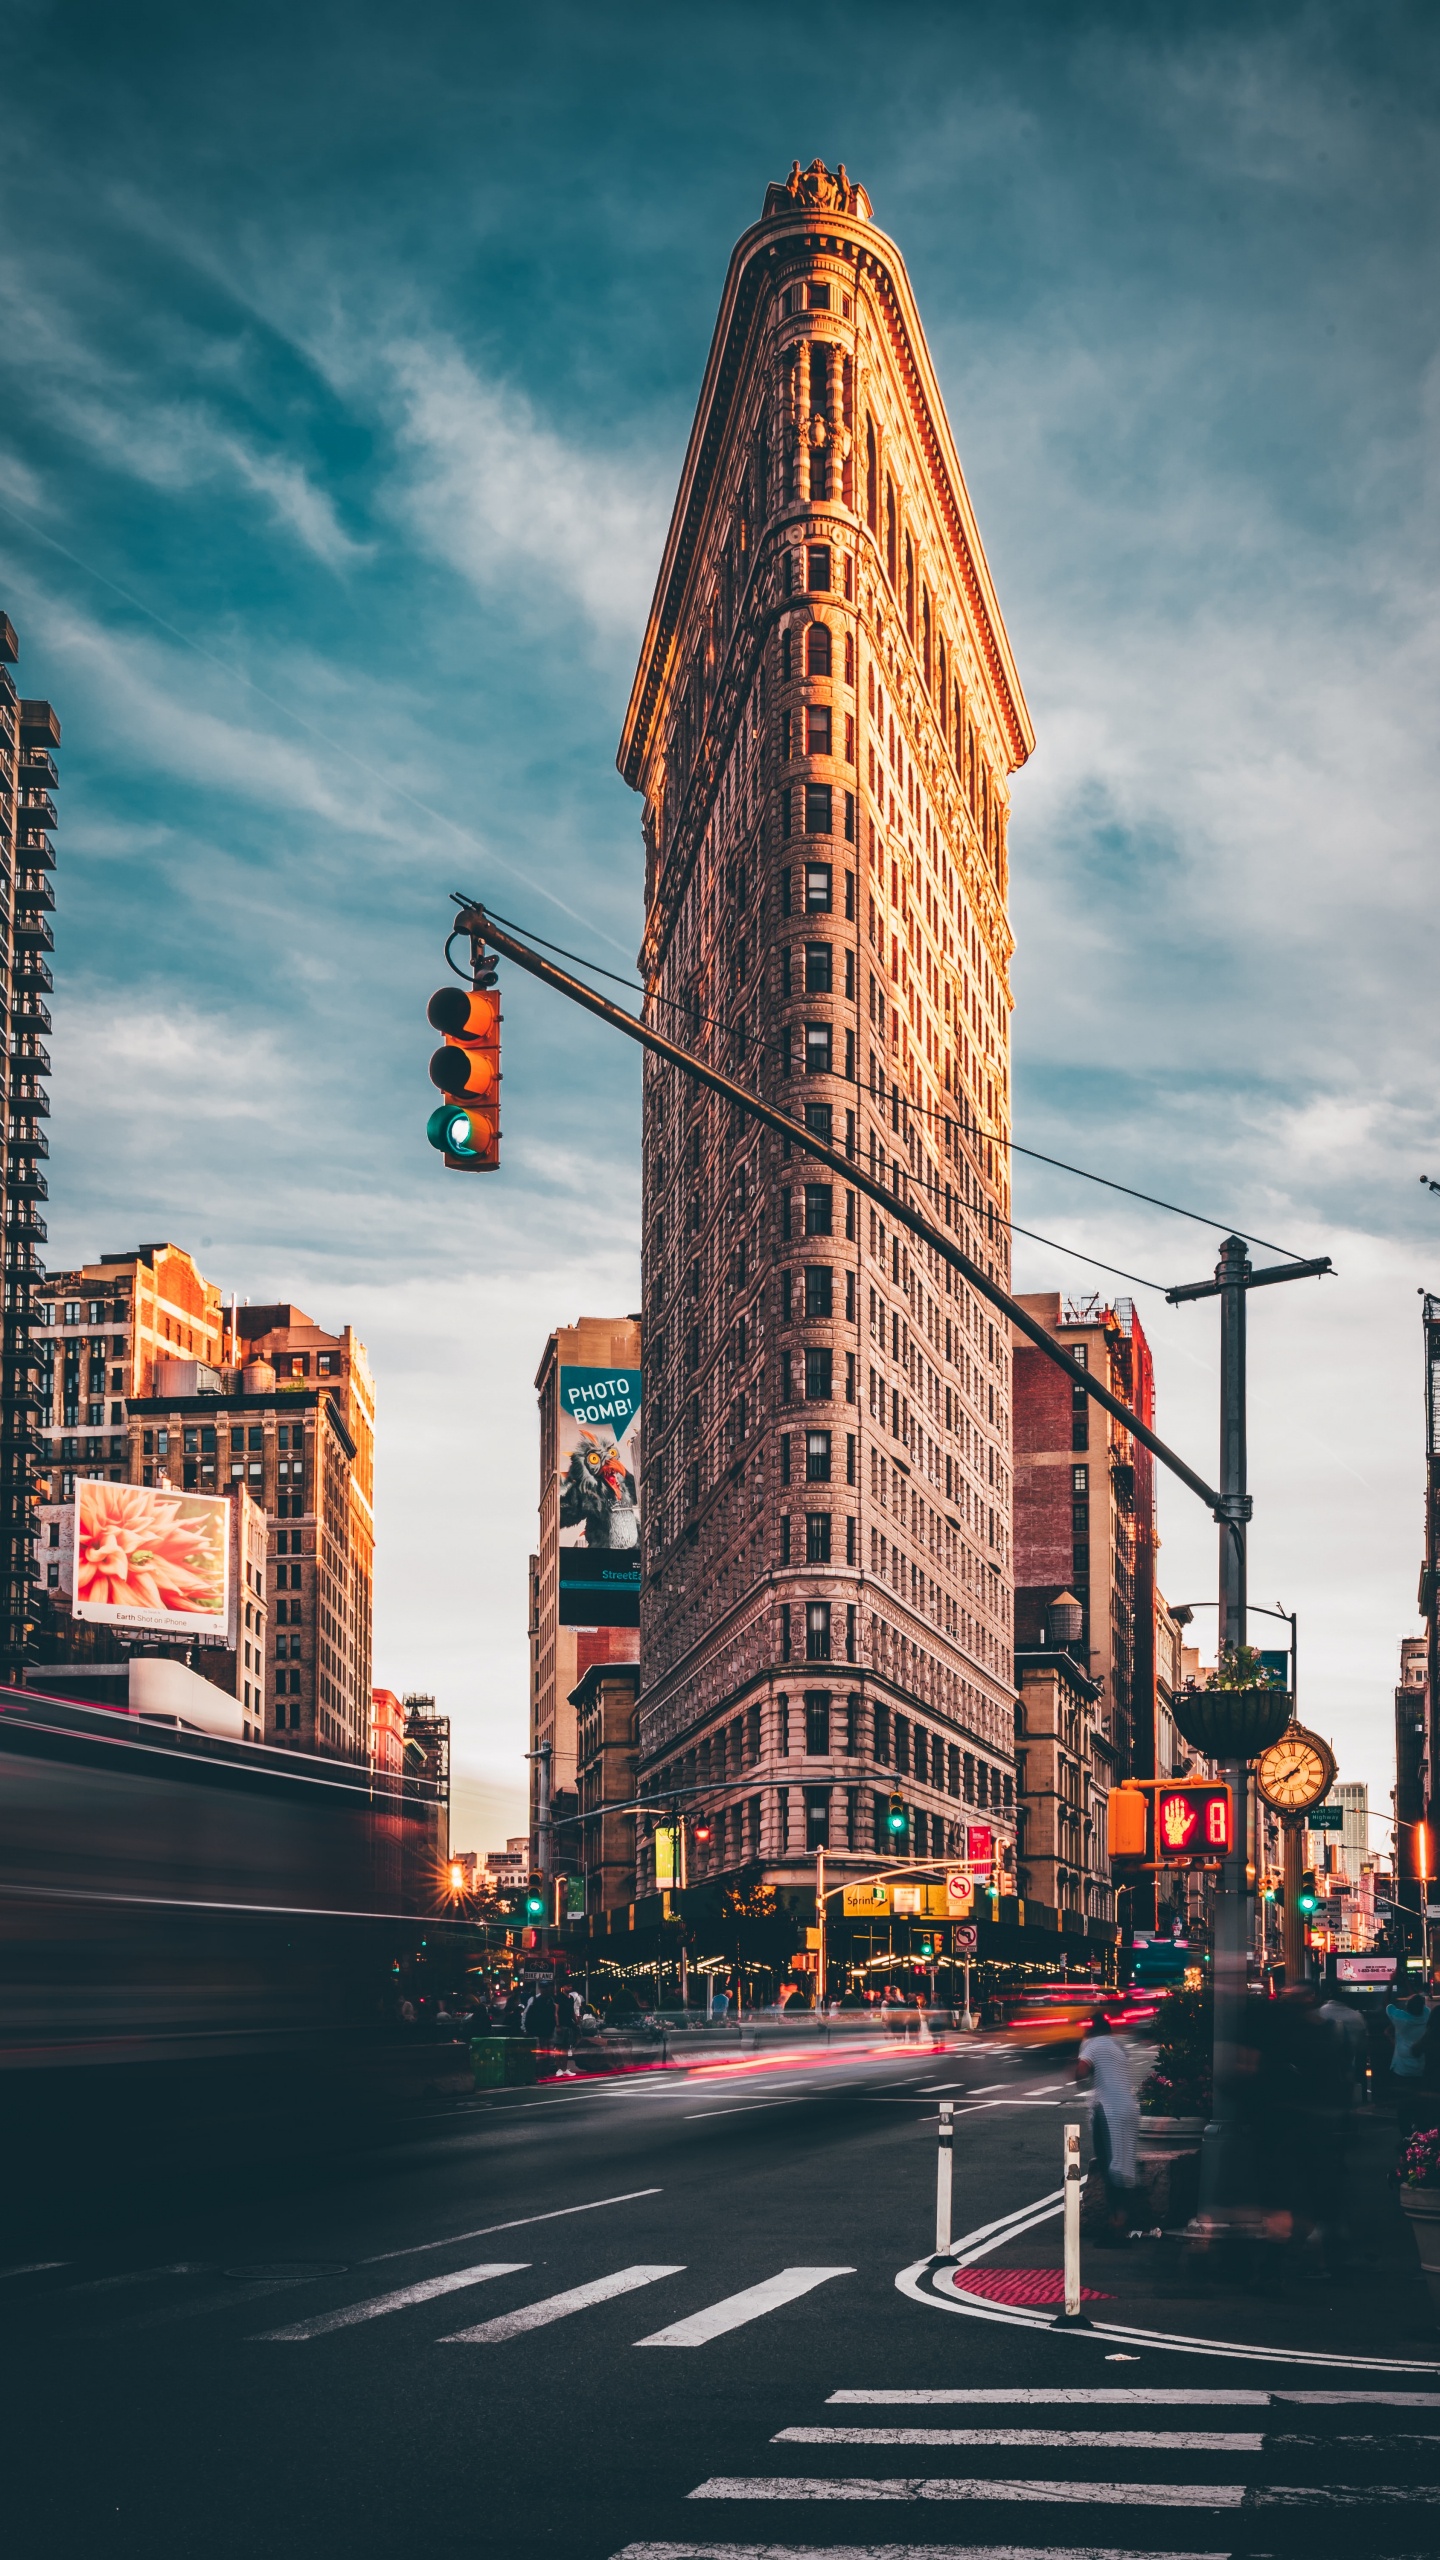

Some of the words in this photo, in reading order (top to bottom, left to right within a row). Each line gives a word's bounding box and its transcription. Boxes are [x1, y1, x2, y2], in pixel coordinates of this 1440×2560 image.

[568, 1378, 630, 1405] PHOTO
[573, 1398, 634, 1425] BOMB!
[116, 1612, 136, 1621] Earth
[137, 1614, 153, 1623] Shot
[164, 1617, 187, 1627] iPhone
[1312, 1814, 1339, 1822] Highway
[847, 1896, 875, 1906] Sprint
[525, 1972, 537, 1980] BIKE
[539, 1972, 554, 1980] LANE
